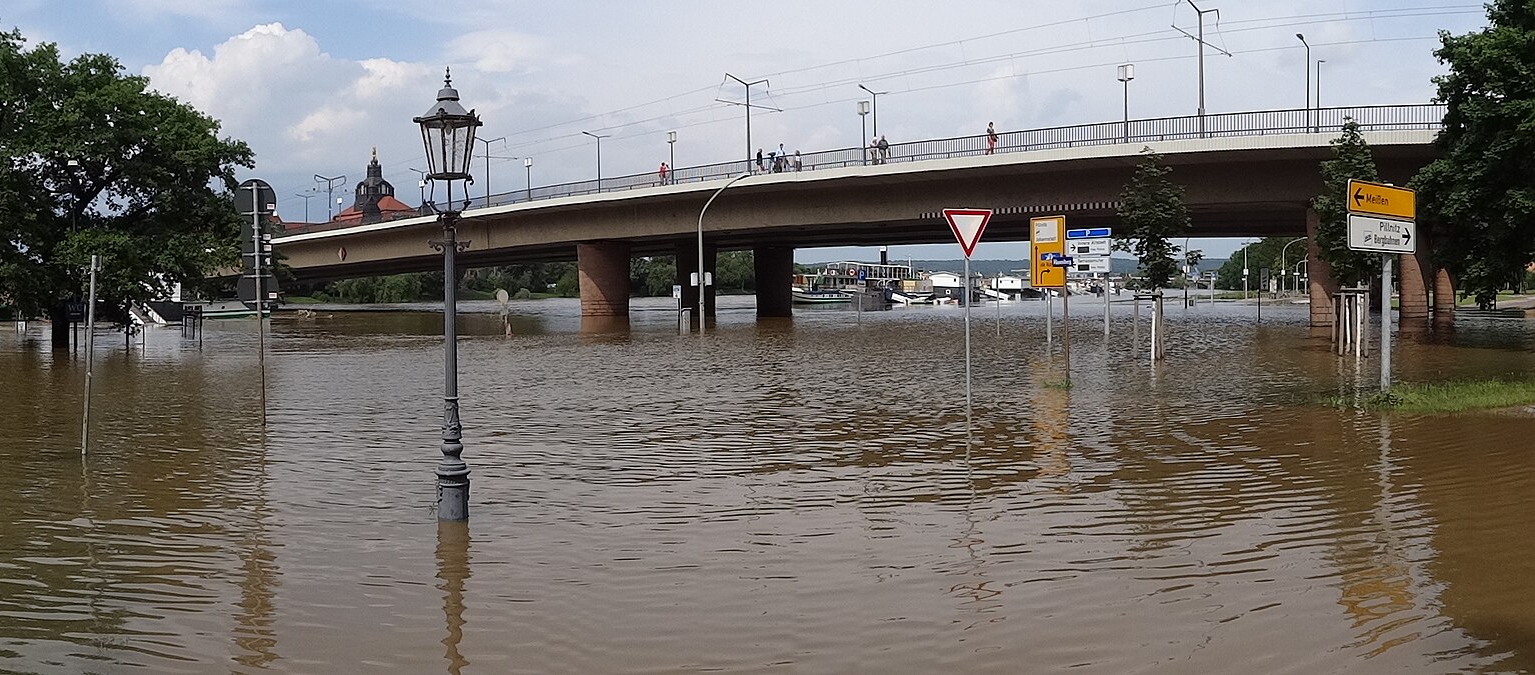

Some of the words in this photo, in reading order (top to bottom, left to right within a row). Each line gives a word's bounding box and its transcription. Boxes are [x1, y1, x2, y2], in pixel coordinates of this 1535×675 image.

[1366, 193, 1389, 206] Meißen
[1379, 222, 1401, 233] Pillnitz
[859, 270, 865, 280] P
